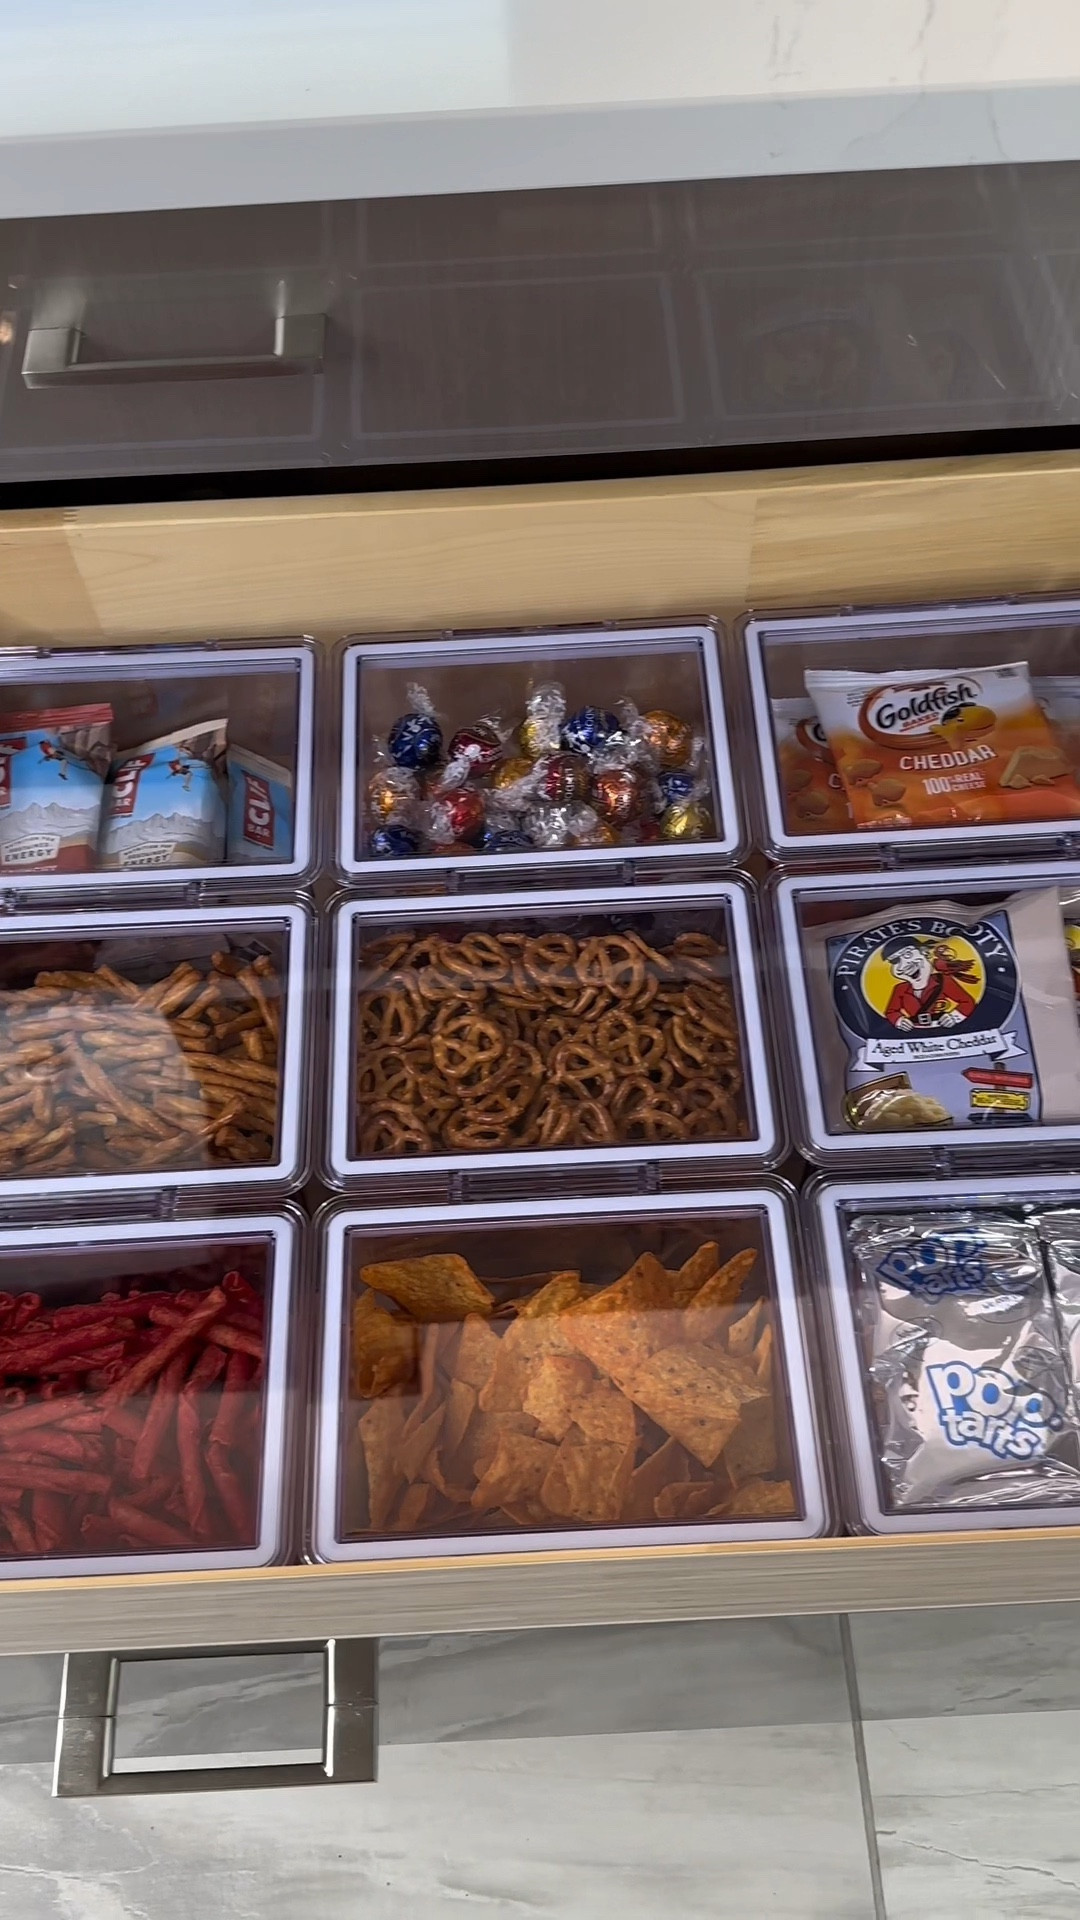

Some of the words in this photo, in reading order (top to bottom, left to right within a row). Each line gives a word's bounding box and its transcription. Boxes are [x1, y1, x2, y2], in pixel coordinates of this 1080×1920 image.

[875, 683, 972, 729] Goldfish
[900, 744, 996, 770] CHEDDAR
[111, 759, 147, 799] CLIF
[246, 776, 271, 826] CLIF
[5, 848, 54, 862] ENERGY
[836, 920, 922, 976] PIRATE'S
[872, 1042, 905, 1058] Aged
[905, 1041, 945, 1053] White
[946, 1035, 997, 1050] Cheddar
